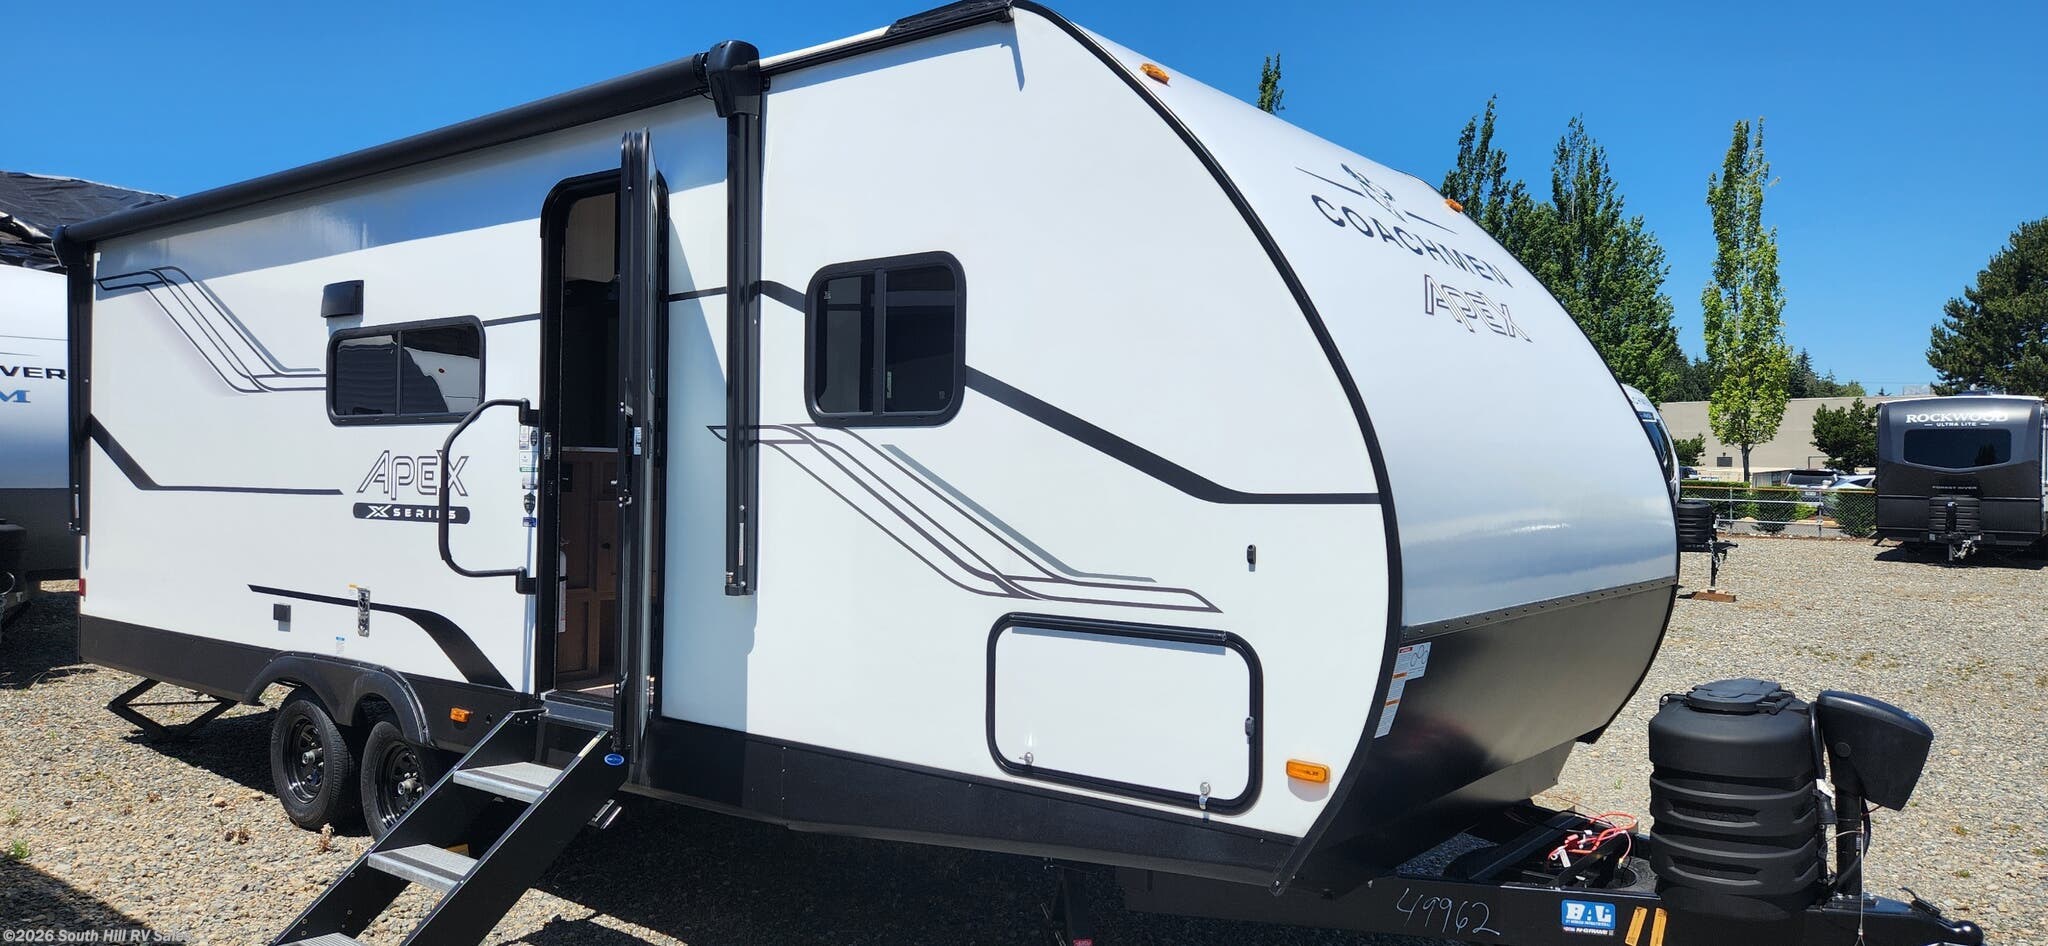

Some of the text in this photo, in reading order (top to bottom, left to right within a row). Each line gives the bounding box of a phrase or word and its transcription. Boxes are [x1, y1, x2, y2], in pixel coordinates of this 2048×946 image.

[1311, 194, 1514, 288] COACHMEN
[1424, 273, 1533, 343] APEX
[1905, 412, 2009, 423] ROCKWOOD
[356, 450, 469, 500] APEX
[1396, 887, 1500, 936] 49962
[1566, 902, 1612, 923] BAL
